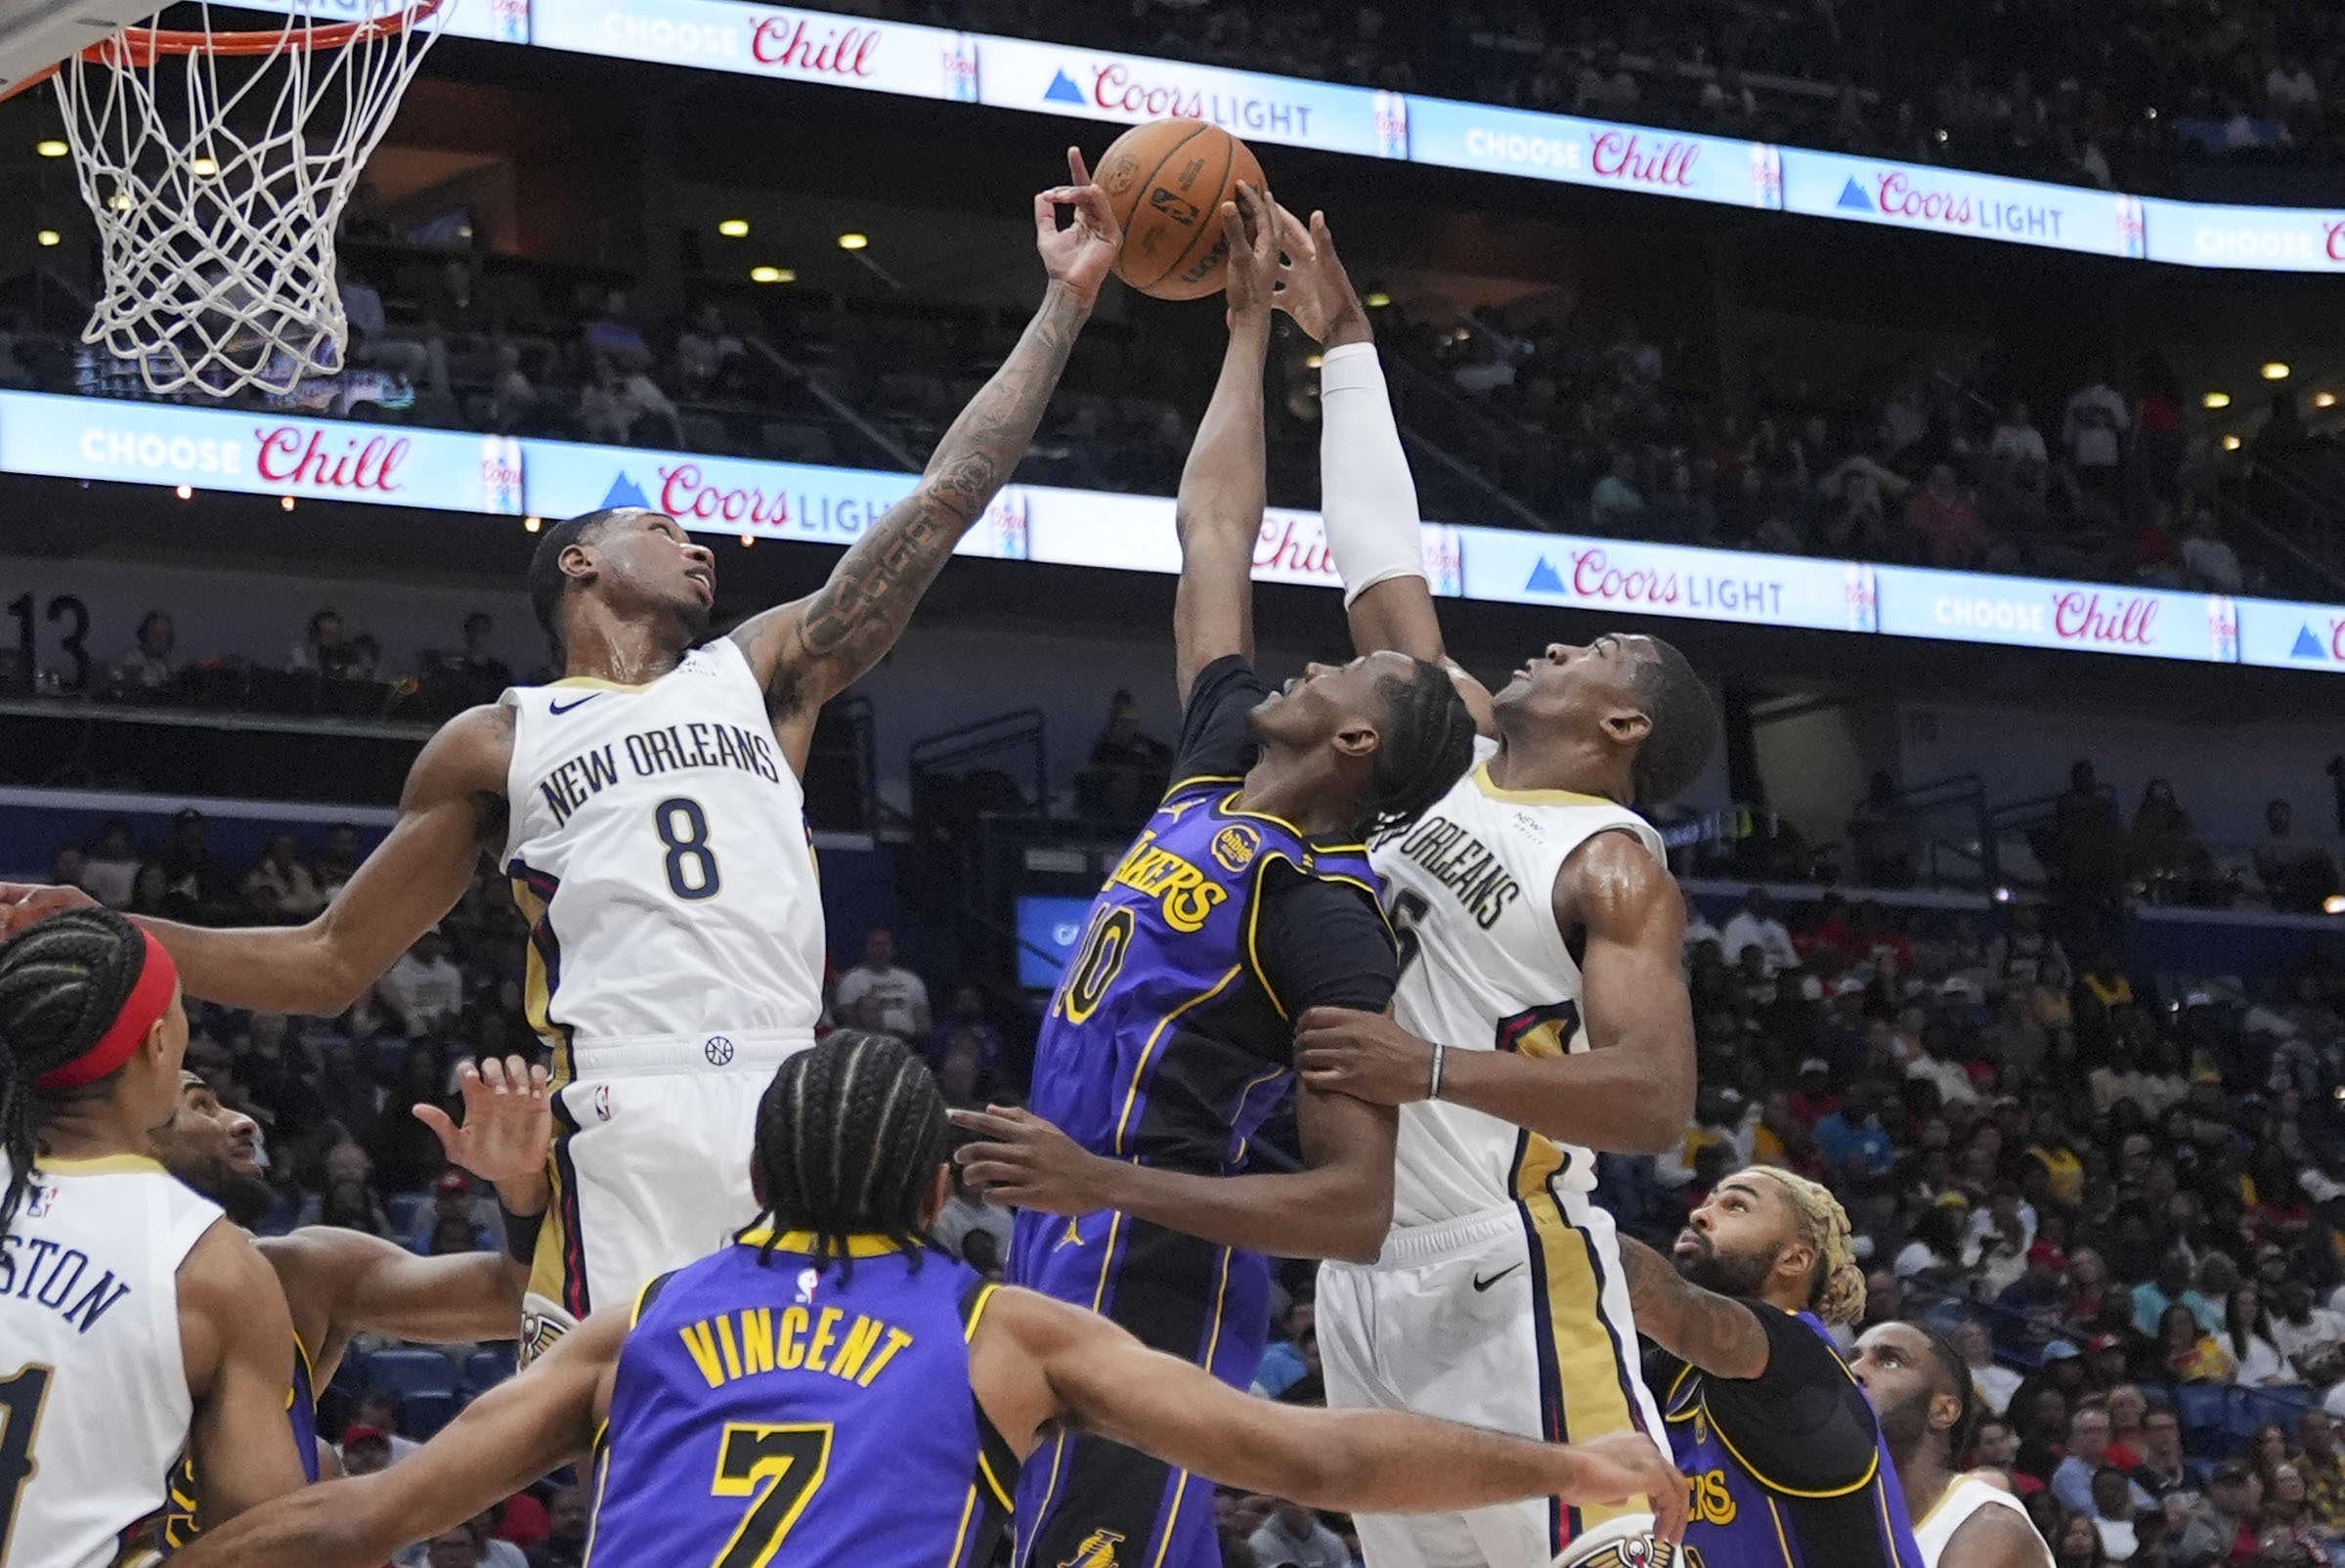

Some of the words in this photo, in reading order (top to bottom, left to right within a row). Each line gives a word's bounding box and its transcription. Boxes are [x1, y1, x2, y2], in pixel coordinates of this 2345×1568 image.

[601, 12, 739, 57] CHOOSE
[749, 16, 880, 77] Chill
[1091, 63, 1202, 118] Coors
[1212, 95, 1313, 137] LIGHT
[1468, 128, 1582, 170] CHOOSE
[1589, 131, 1702, 188] Chill
[1877, 171, 1976, 225] Coors
[1979, 199, 2063, 239] LIGHT
[2193, 226, 2315, 260] CHOOSE
[81, 427, 242, 475] CHOOSE
[254, 425, 412, 492] Chill
[658, 463, 792, 527] Coors
[1571, 548, 1679, 604] Coors
[1688, 574, 1786, 616] LIGHT
[8, 591, 96, 688] 13
[1934, 596, 2046, 633] CHOOSE
[2054, 591, 2158, 645] Chill
[540, 743, 619, 829] NEW
[625, 721, 780, 784] ORLEANS
[652, 795, 723, 902] 8
[1400, 815, 1520, 930] ORLEANS
[677, 1304, 914, 1389] VINCENT
[710, 1420, 835, 1568] 7
